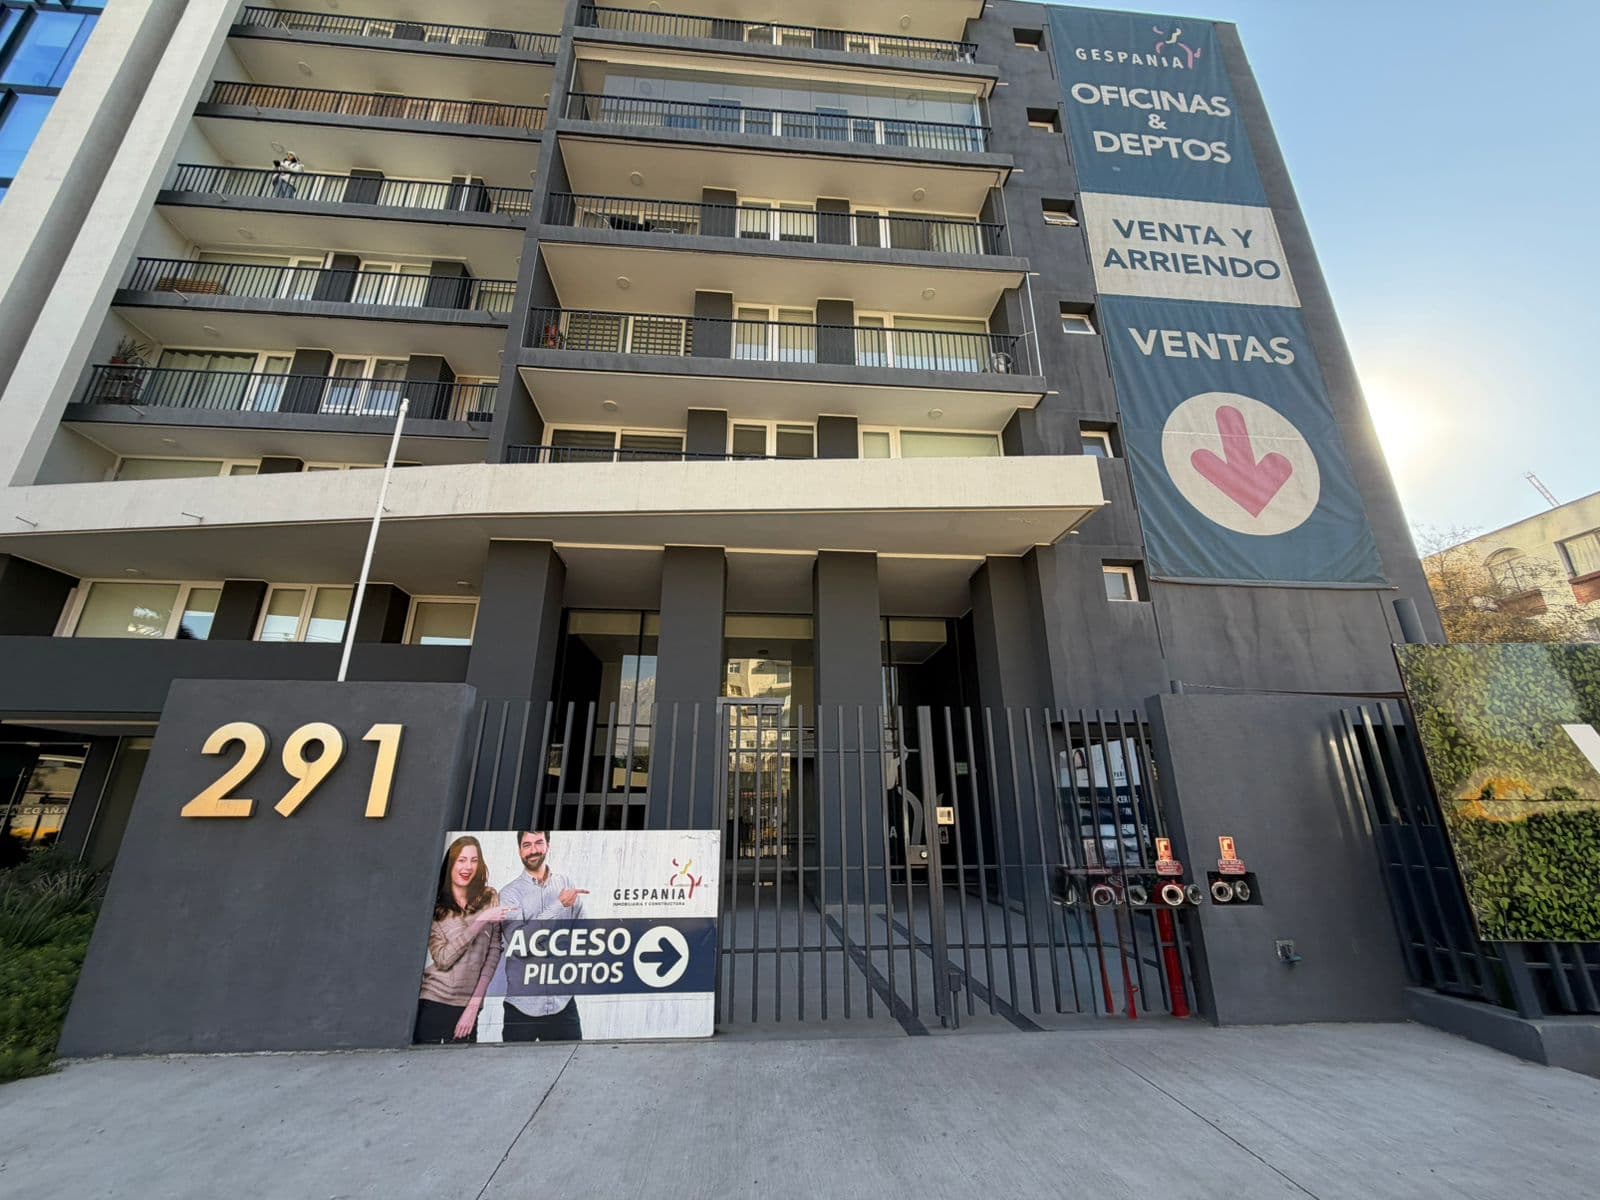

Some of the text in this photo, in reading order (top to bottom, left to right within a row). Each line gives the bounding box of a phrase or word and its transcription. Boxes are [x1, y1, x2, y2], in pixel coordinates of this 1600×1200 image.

[1075, 48, 1183, 69] GESPANIA
[1071, 83, 1231, 117] OFICINAS
[1148, 114, 1167, 130] &
[1093, 131, 1231, 164] DEPTOS
[1112, 219, 1252, 248] VENTA Y
[1104, 248, 1280, 280] ARRIENDO
[1128, 328, 1295, 365] VENTAS
[181, 722, 405, 817] 291
[613, 888, 685, 900] GESPANIA
[505, 928, 631, 957] ACCESO
[523, 962, 624, 985] PILOTOS
